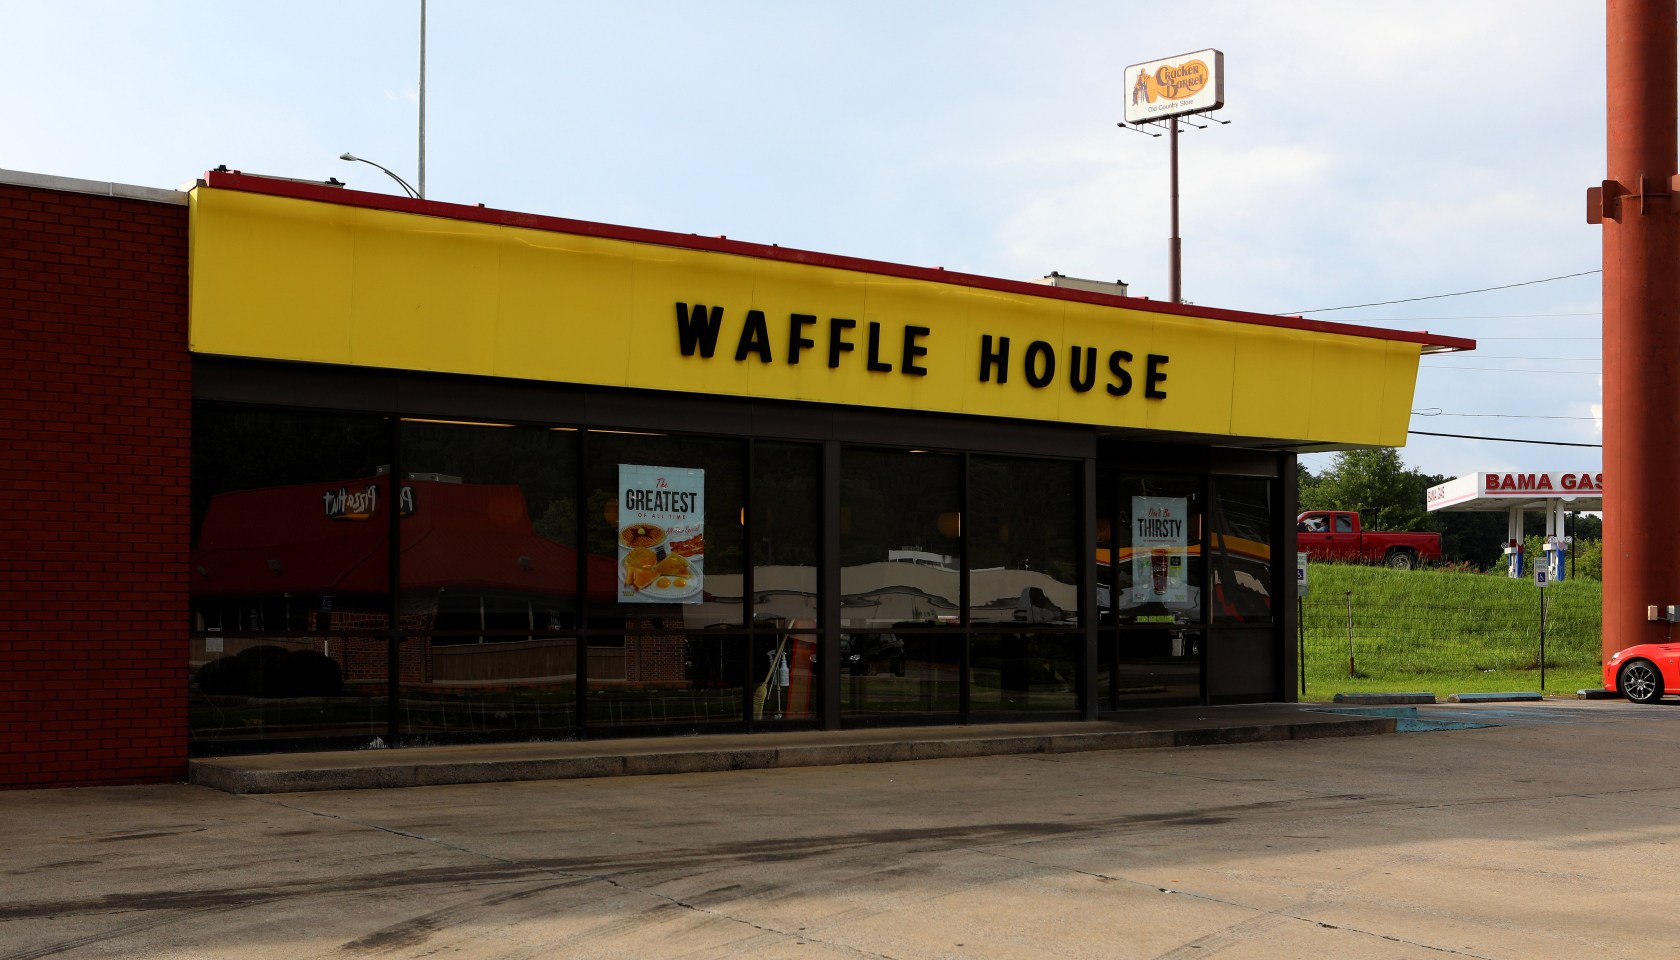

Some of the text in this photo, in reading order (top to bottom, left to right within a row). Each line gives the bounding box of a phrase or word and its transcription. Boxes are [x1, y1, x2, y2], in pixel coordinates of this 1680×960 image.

[1156, 65, 1199, 86] Cracker
[1166, 74, 1203, 98] Barrel
[676, 302, 1169, 399] WAFFLE HOUSE
[656, 477, 668, 488] The
[1485, 473, 1553, 490] BAMA
[626, 488, 698, 513] GREATEST
[1137, 518, 1182, 538] THIRSTY
